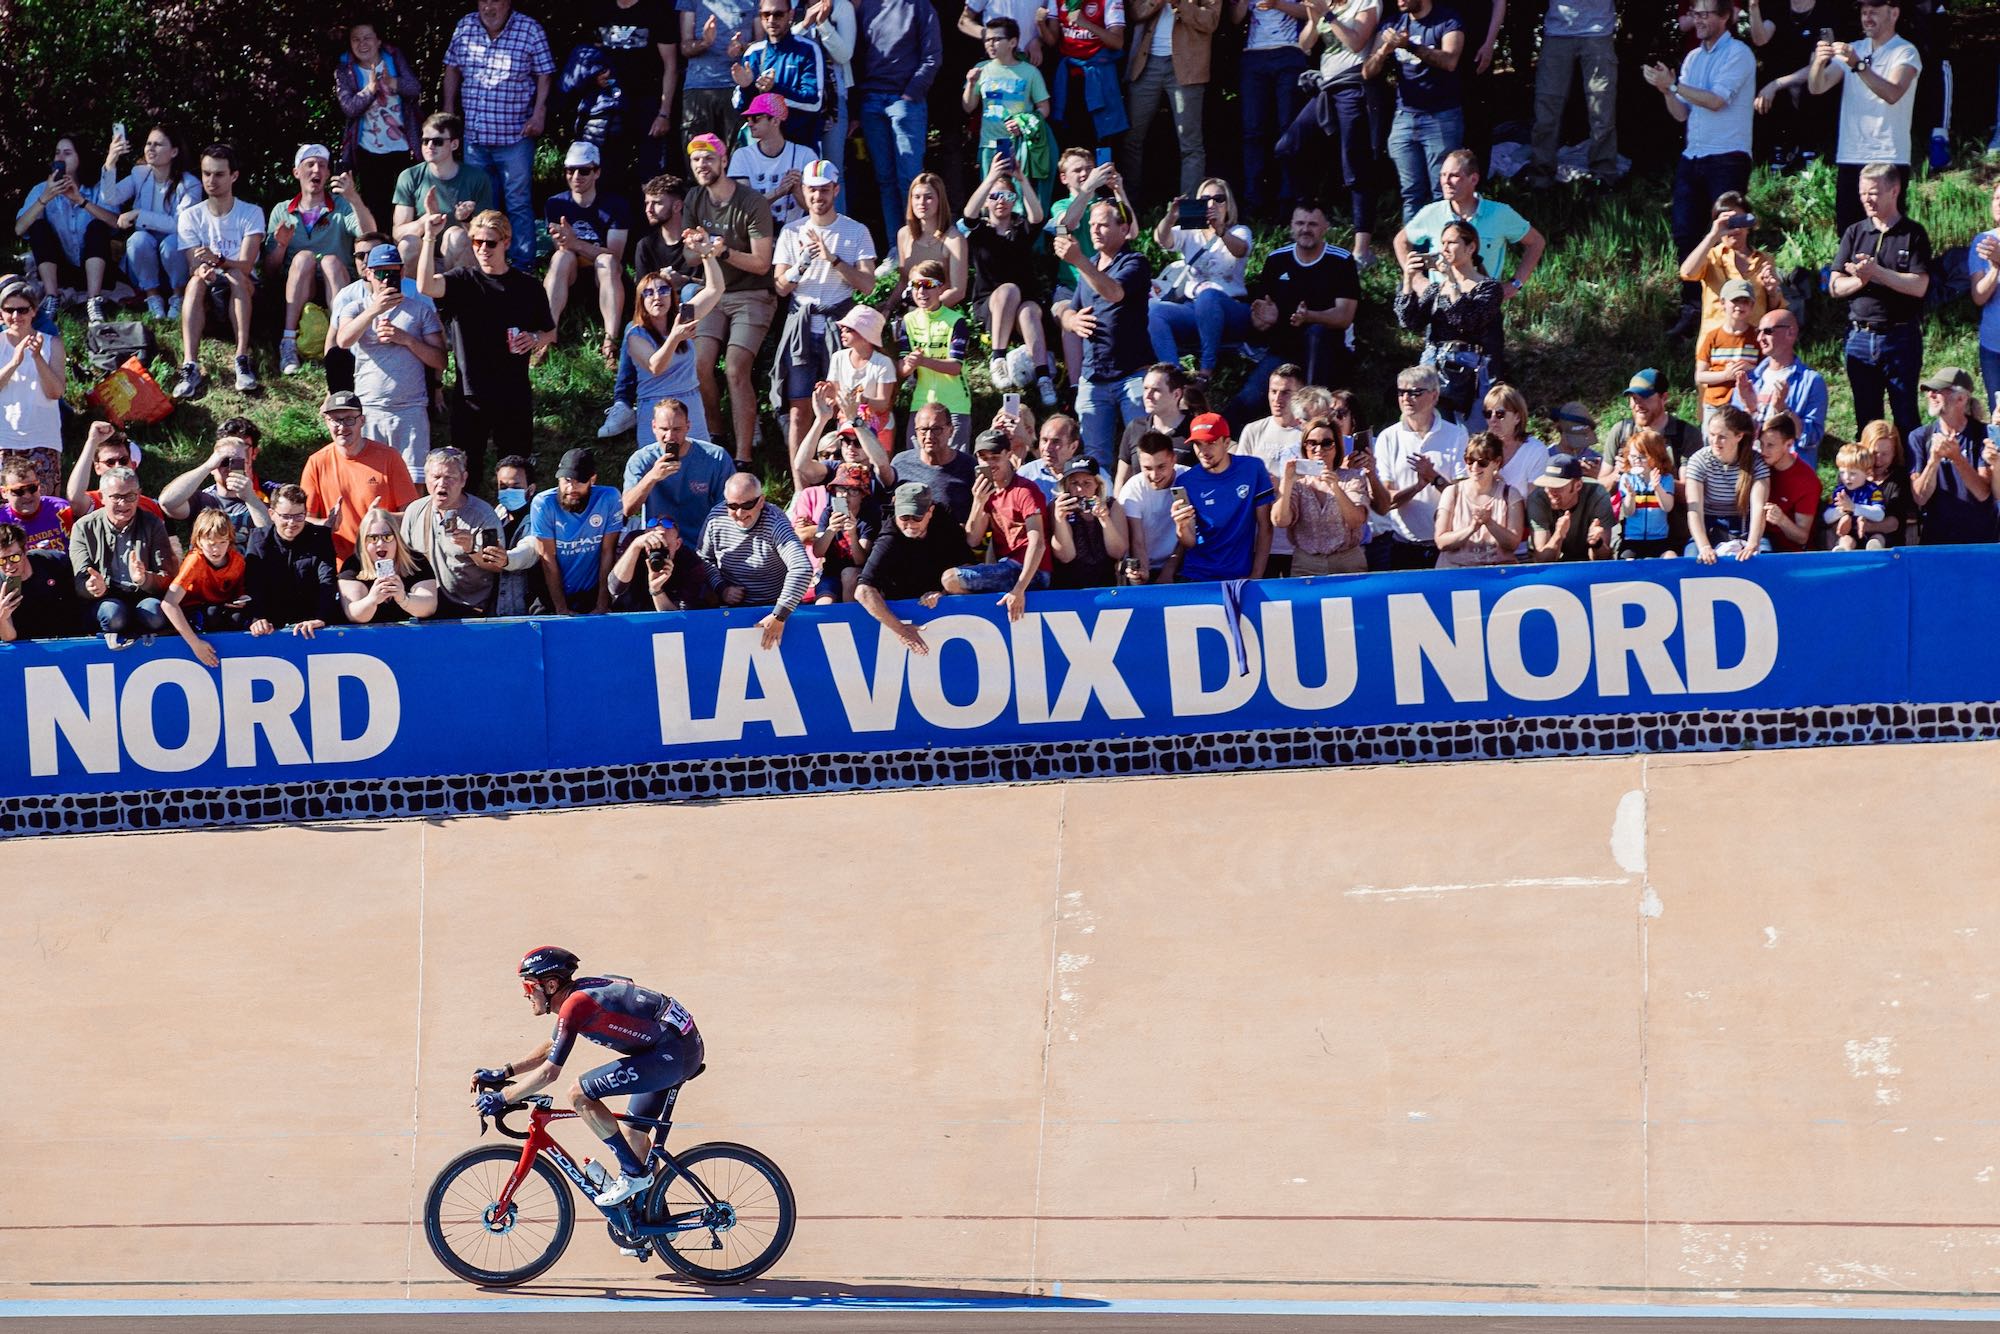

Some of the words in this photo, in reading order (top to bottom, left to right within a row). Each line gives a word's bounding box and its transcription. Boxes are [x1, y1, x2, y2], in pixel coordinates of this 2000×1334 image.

[25, 653, 401, 777] NORD
[652, 626, 809, 745] LA
[818, 607, 1145, 733] VOIX
[1163, 596, 1358, 717] DU
[1388, 576, 1779, 705] NORD
[594, 1066, 640, 1093] INEOS
